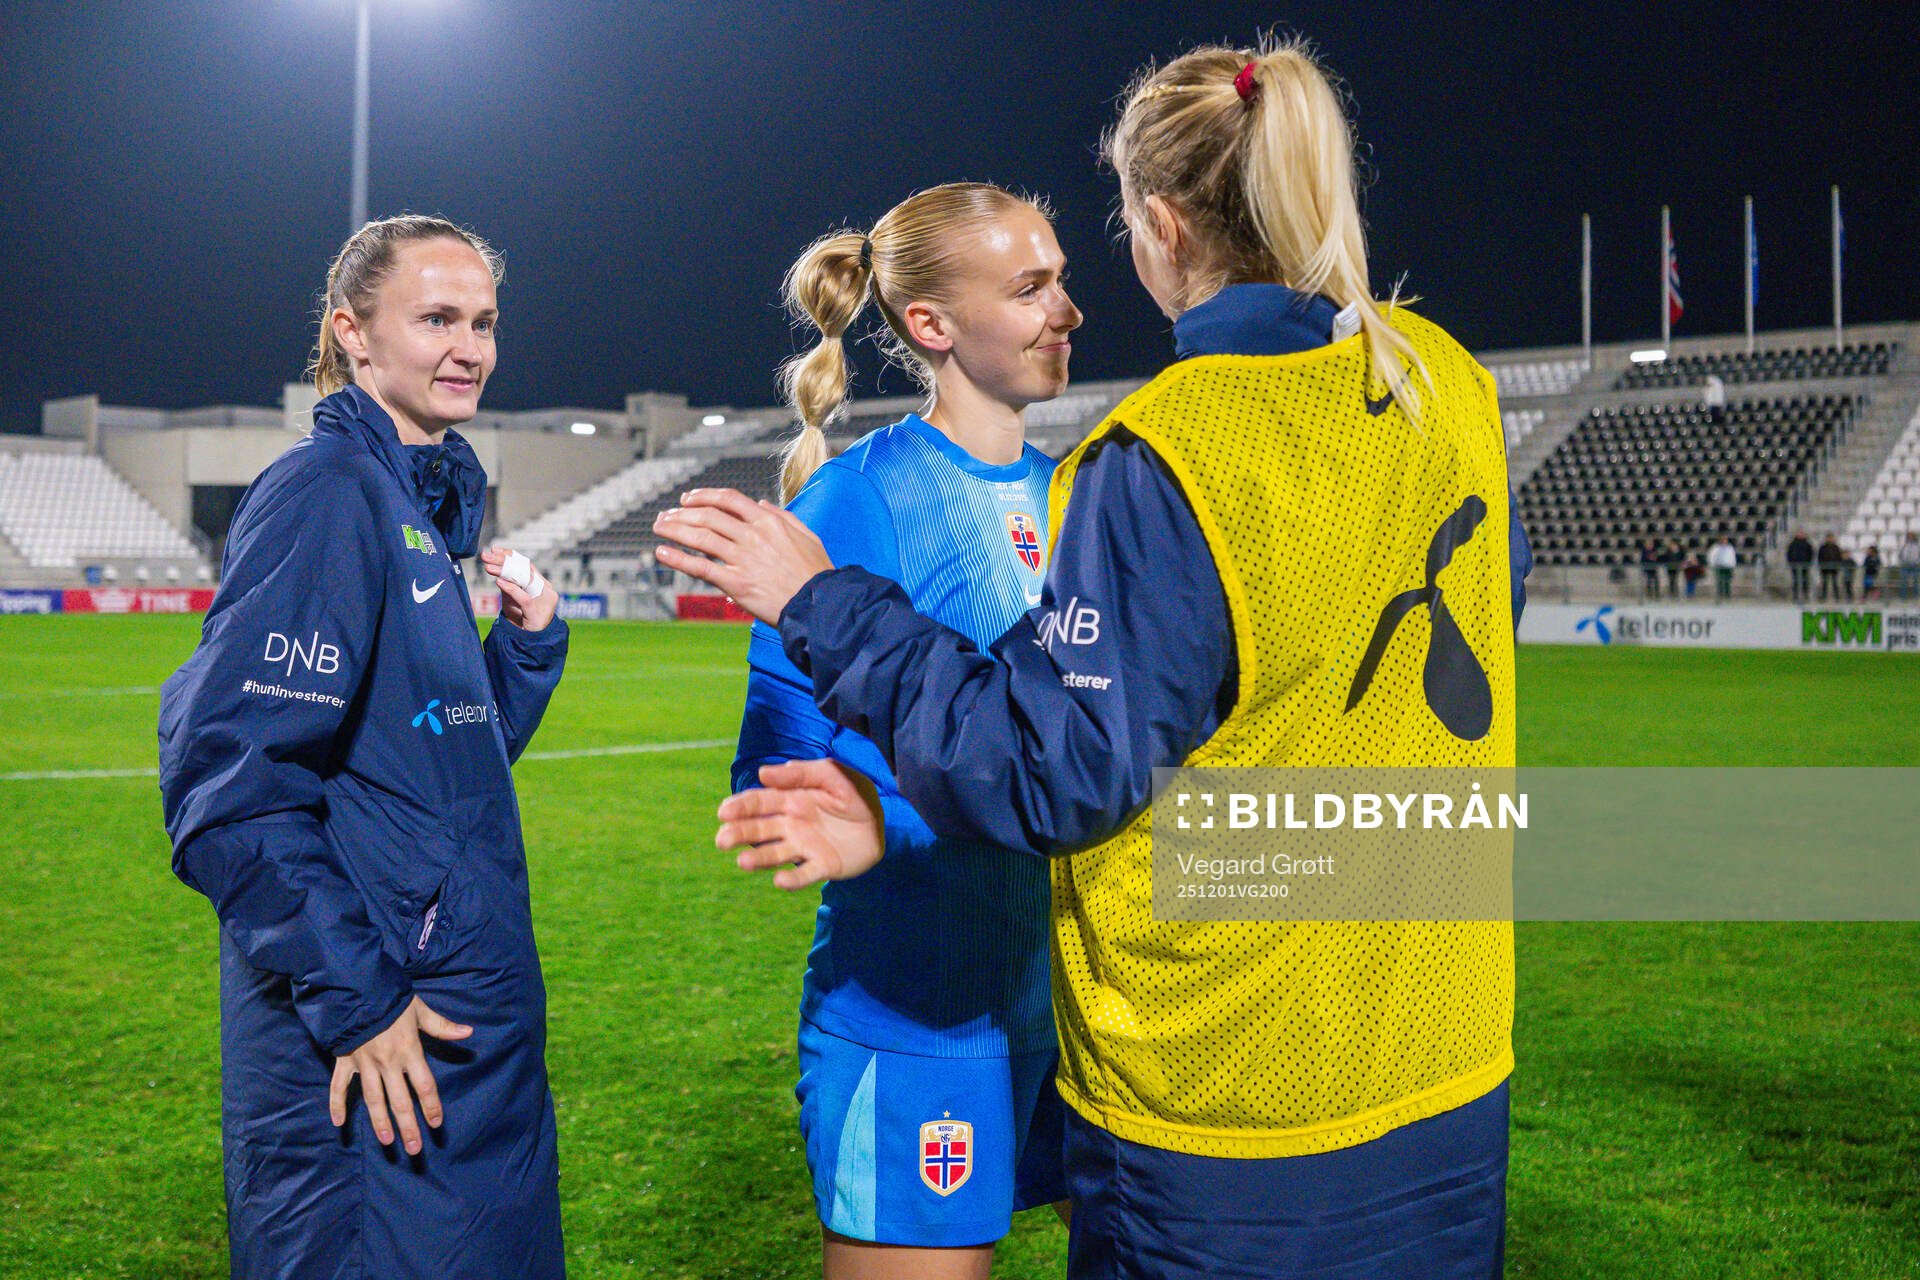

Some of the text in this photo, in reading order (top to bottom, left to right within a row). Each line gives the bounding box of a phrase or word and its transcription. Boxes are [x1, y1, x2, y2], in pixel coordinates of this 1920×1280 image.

[141, 592, 190, 612] TINE
[1617, 612, 1715, 639] telenor
[1802, 612, 1882, 643] KIWI
[1888, 614, 1920, 627] min
[264, 632, 340, 677] DNB
[242, 680, 346, 708] #huninvesterer
